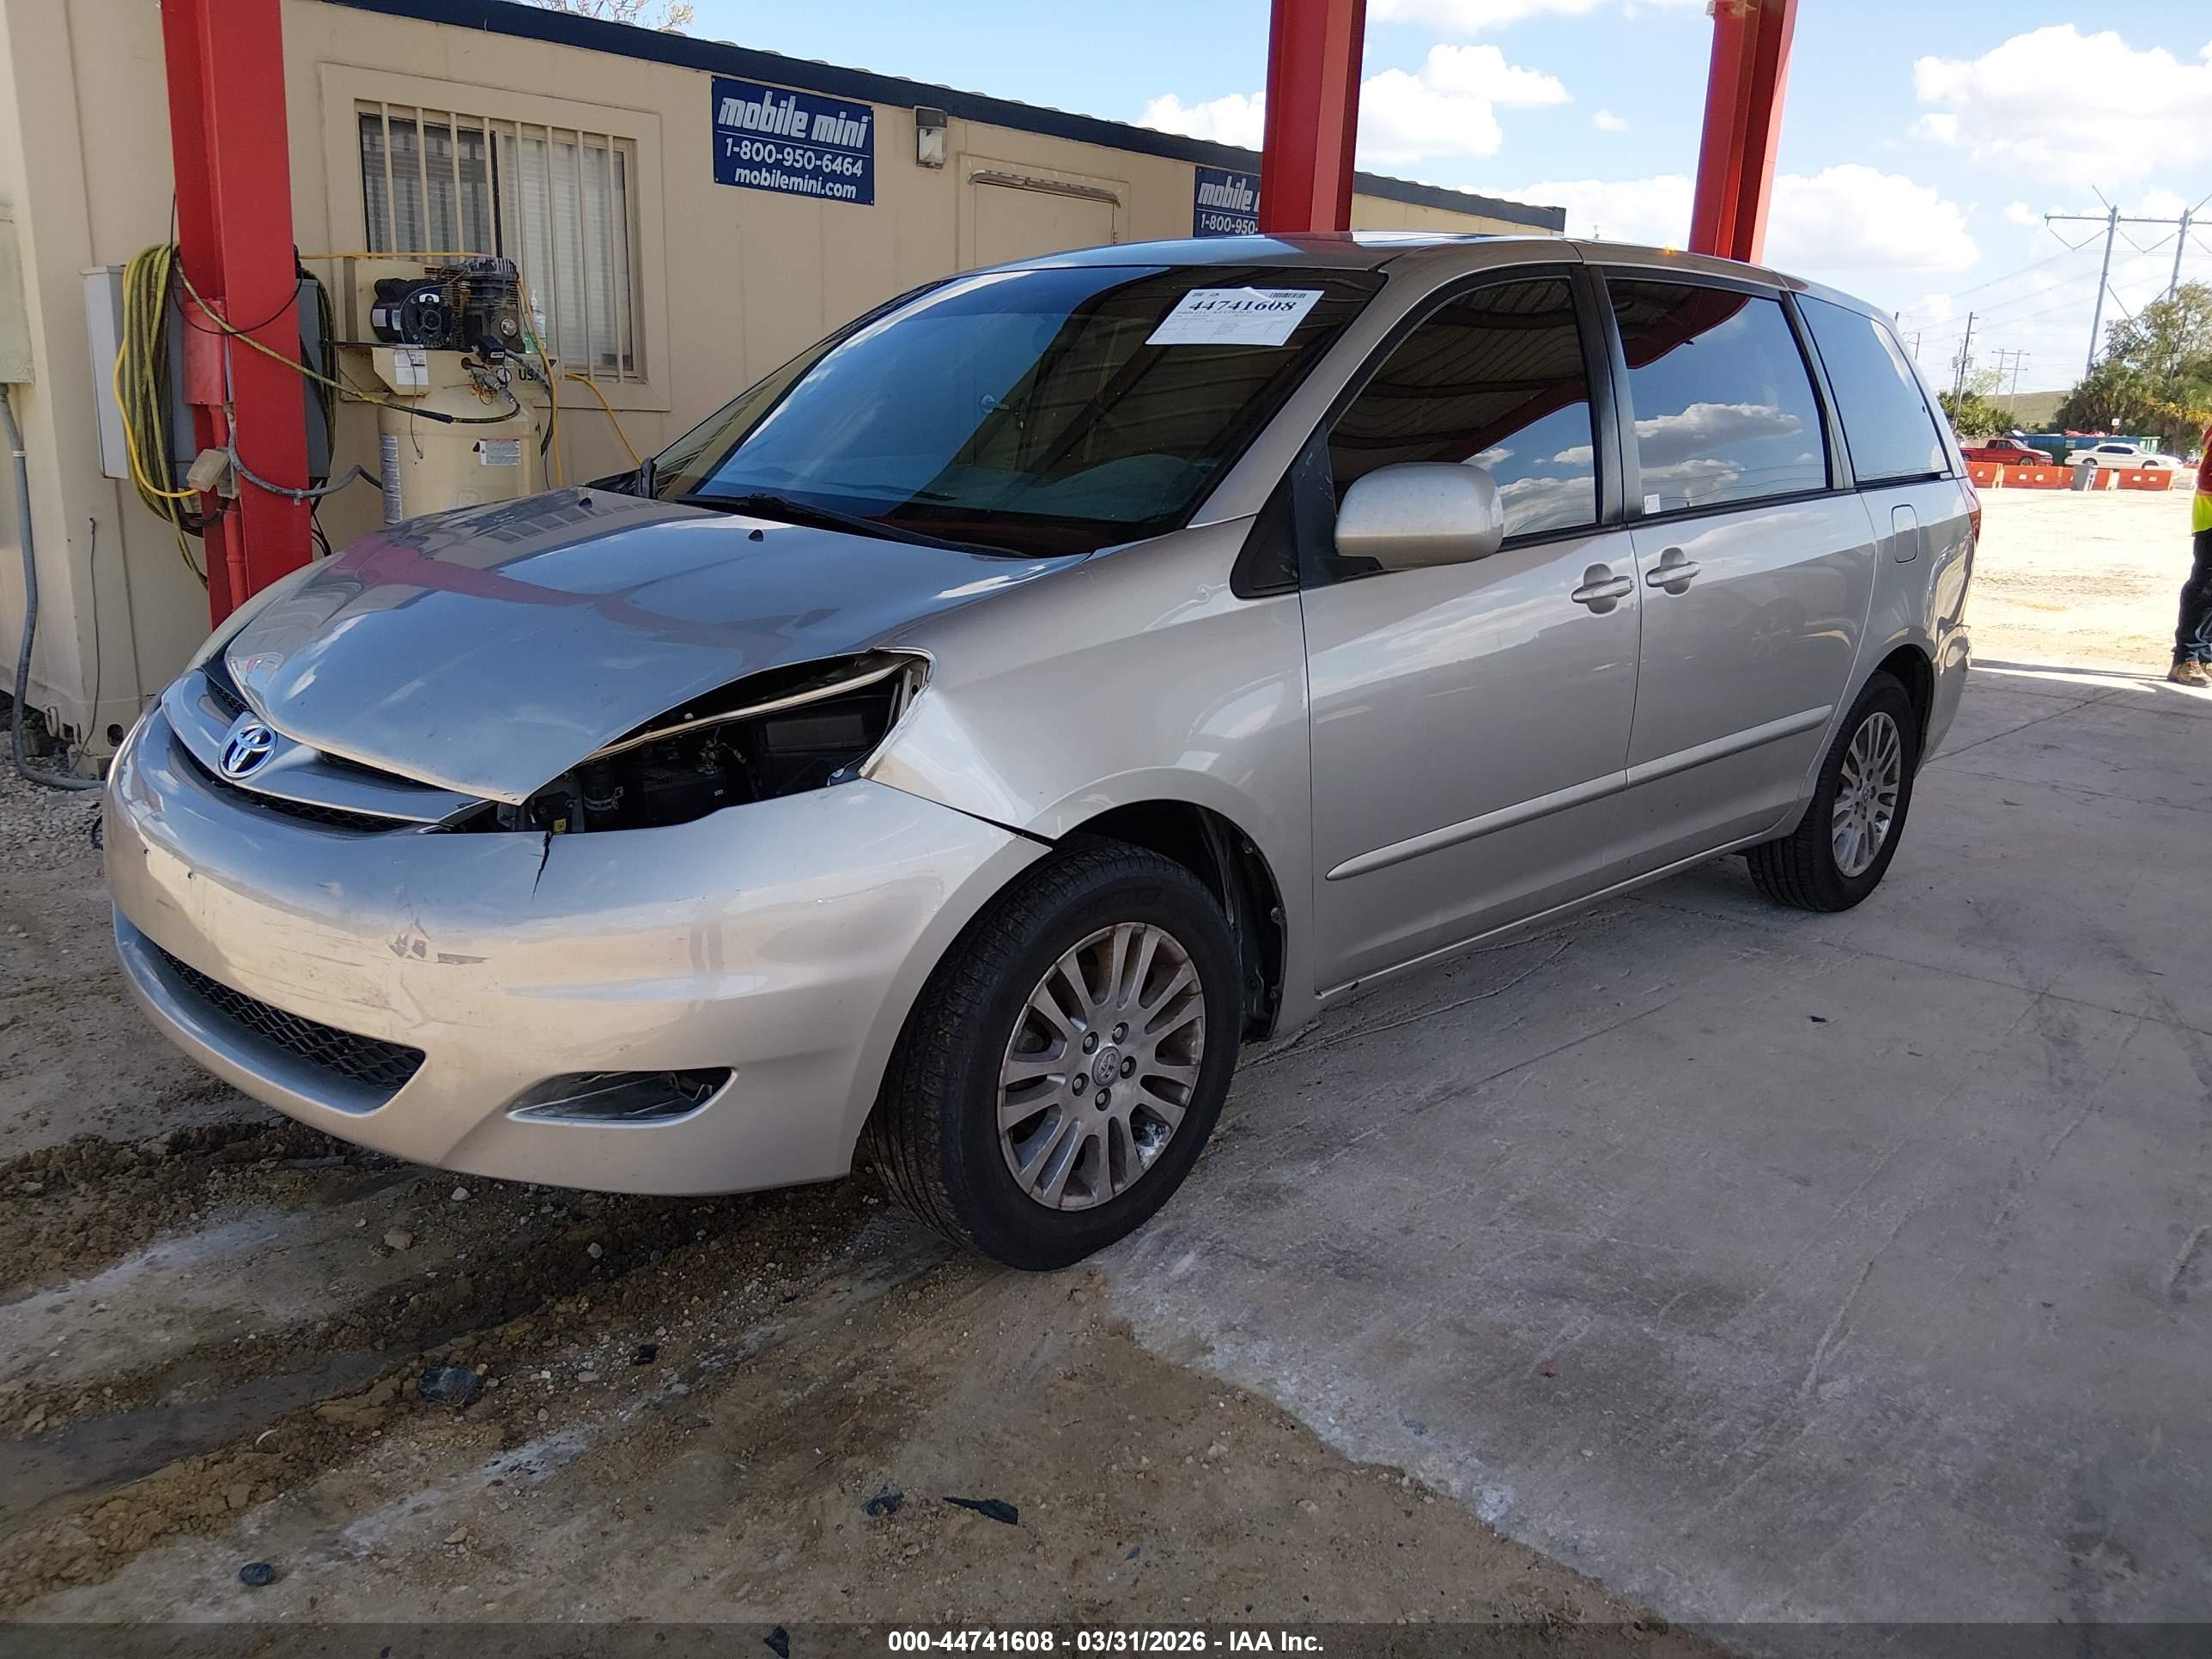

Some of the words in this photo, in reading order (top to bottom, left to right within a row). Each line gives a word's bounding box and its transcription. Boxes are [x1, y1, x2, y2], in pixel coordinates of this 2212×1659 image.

[718, 90, 809, 138] mobile
[811, 111, 869, 149] mini
[726, 137, 863, 177] 1-800-950-6464
[734, 167, 857, 199] mobilemini.com
[1197, 175, 1254, 211] mobile
[1188, 301, 1297, 312] 44741608
[519, 368, 537, 381] US
